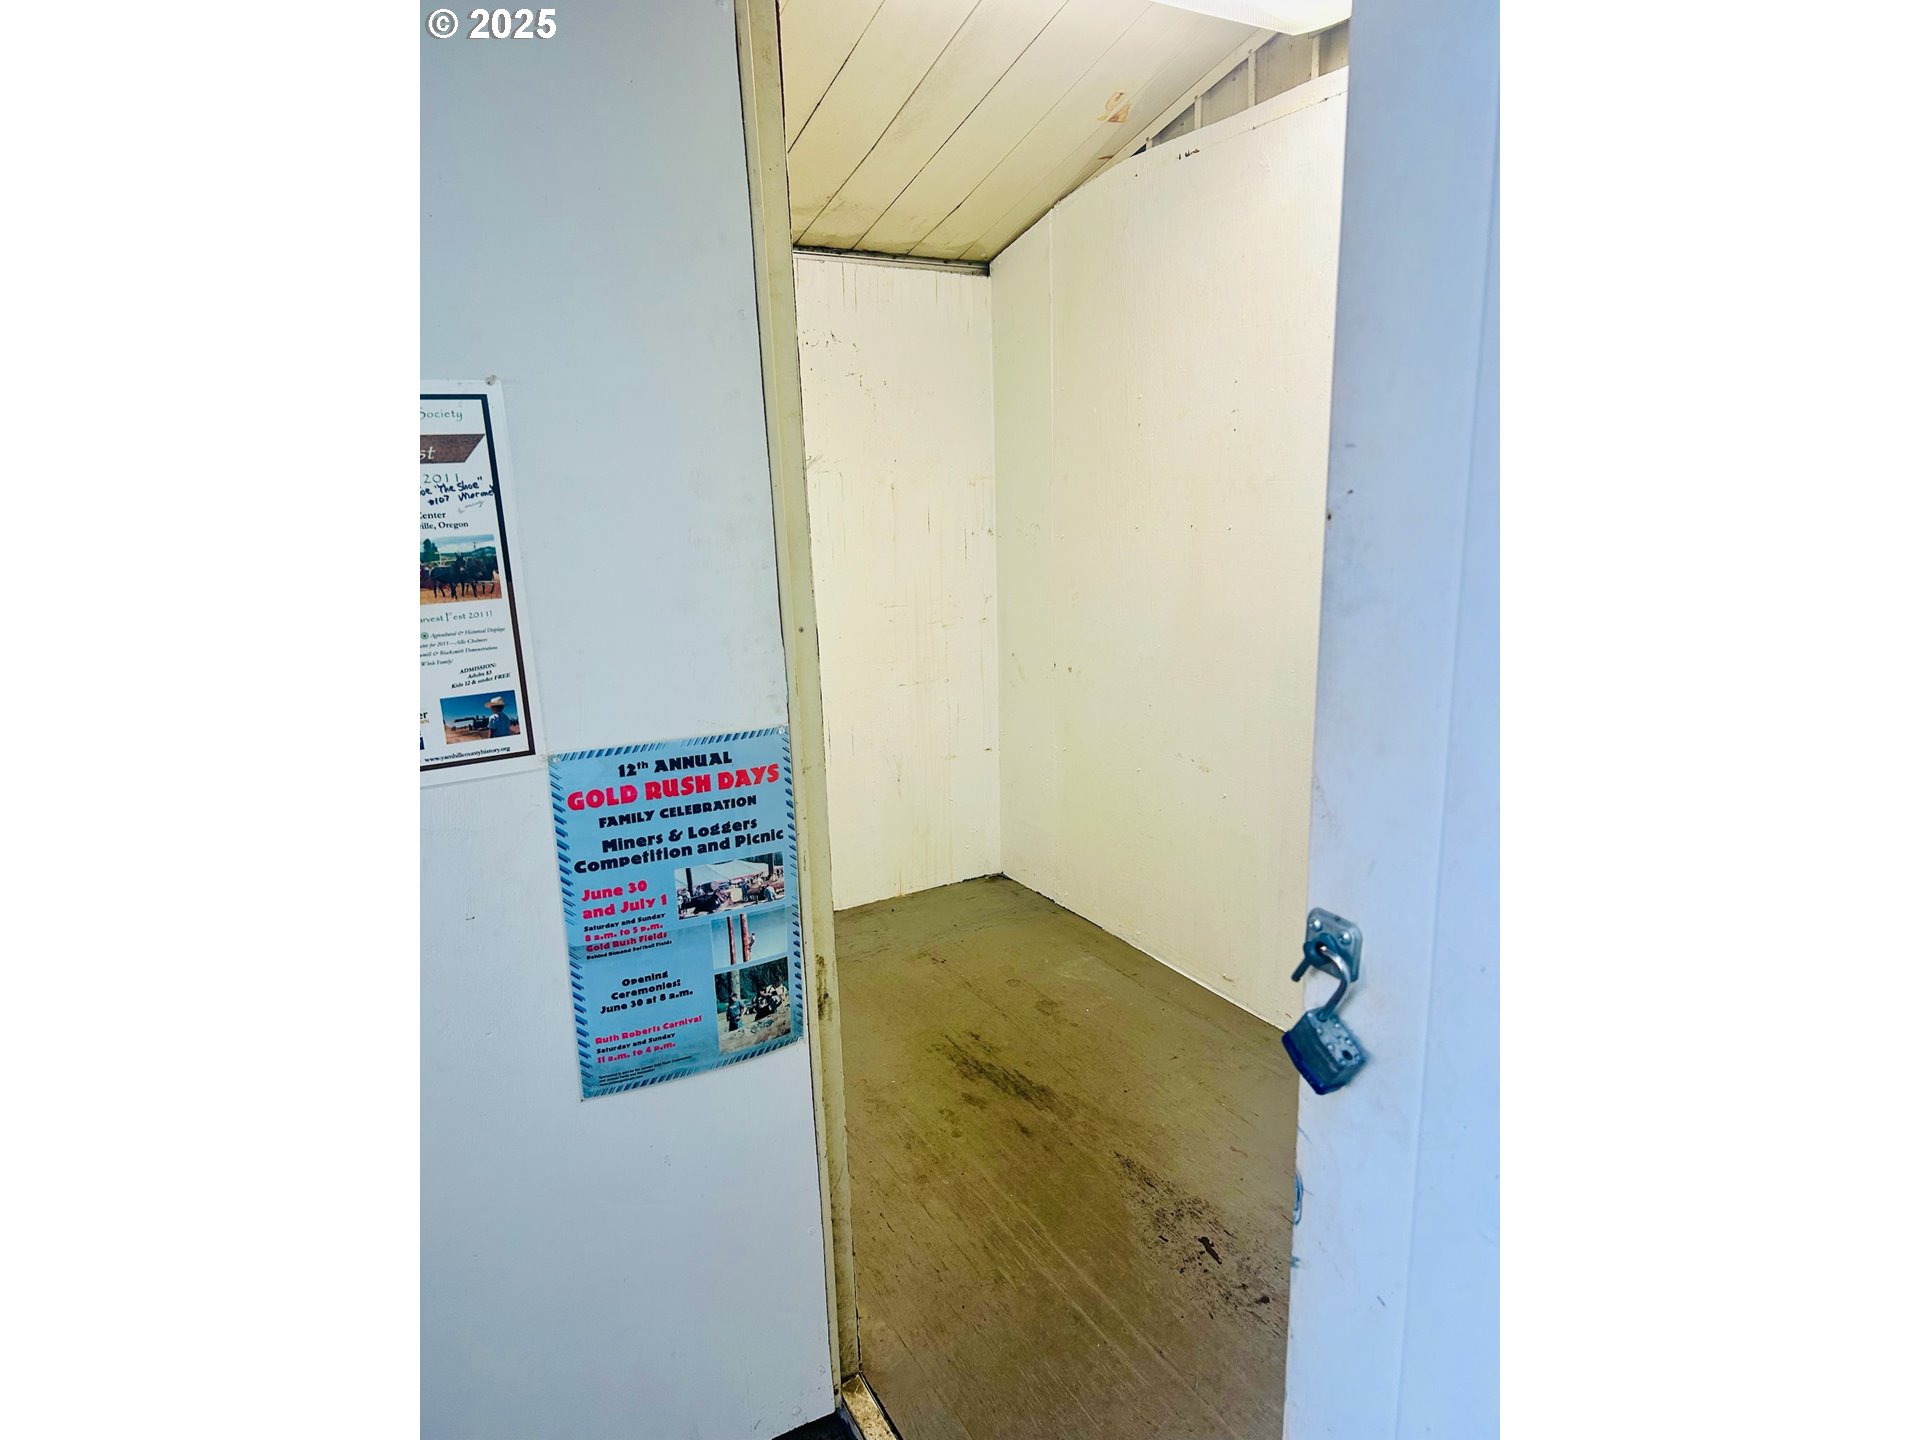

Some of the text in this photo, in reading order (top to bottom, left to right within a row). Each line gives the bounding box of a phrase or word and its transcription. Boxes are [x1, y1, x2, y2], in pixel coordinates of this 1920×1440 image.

[424, 473, 459, 484] 2011
[438, 521, 469, 530] Oregon
[451, 681, 464, 689] Kids
[477, 675, 494, 684] under
[494, 672, 512, 681] FREE
[467, 671, 485, 679] Adults
[618, 751, 733, 778] 12th ANNUAL
[567, 763, 780, 811] GOLD RUSH DAYS
[598, 795, 758, 829] FAMILY CELEBRATION
[601, 818, 758, 853] Miners & Loggers
[574, 827, 784, 874] Competition and Picnic
[581, 880, 648, 902] June 30
[582, 894, 668, 920] and July 1
[584, 913, 666, 932] Saturday and Sunday
[584, 923, 664, 942] 8 a.m. to 5 p.m.
[586, 931, 668, 953] Gold Rush Fields
[586, 952, 608, 960] Behind
[633, 943, 655, 951] Softball
[621, 970, 669, 987] Opening
[600, 989, 693, 1014] June 30 at 8 a.m.
[595, 1015, 703, 1045] Ruth Roberts Carnival
[596, 1032, 676, 1055] Saturday and Sunday
[597, 1042, 676, 1064] 11 a.m. to 4 p.m.
